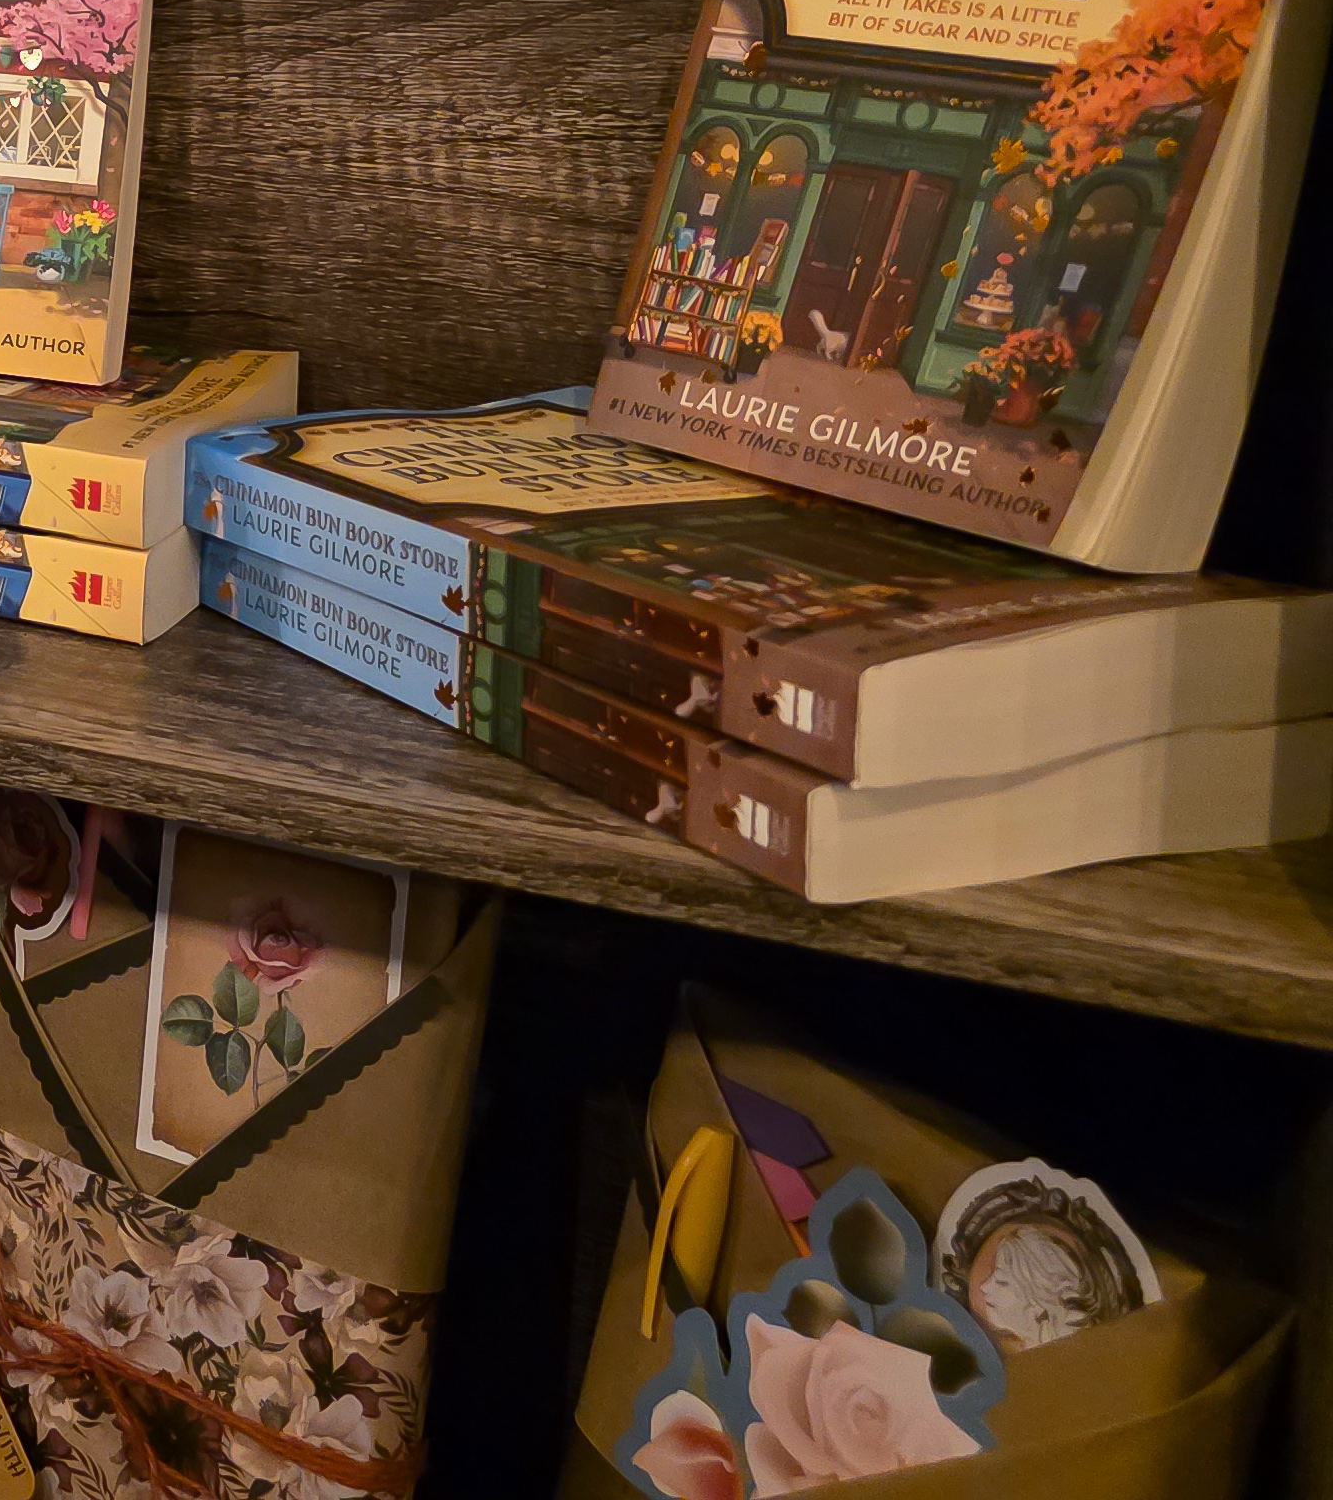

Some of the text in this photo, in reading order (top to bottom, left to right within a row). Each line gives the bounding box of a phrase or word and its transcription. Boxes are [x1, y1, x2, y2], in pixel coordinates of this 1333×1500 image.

[828, 11, 860, 30] BIT
[865, 14, 889, 34] OF
[893, 16, 961, 41] SUGAR
[965, 25, 1014, 46] AND
[966, 0, 986, 19] IS
[990, 3, 1007, 21] A
[1012, 3, 1081, 29] LITTLE
[0, 333, 85, 355] AUTHOR
[679, 381, 978, 476] LAURIE GILMORE
